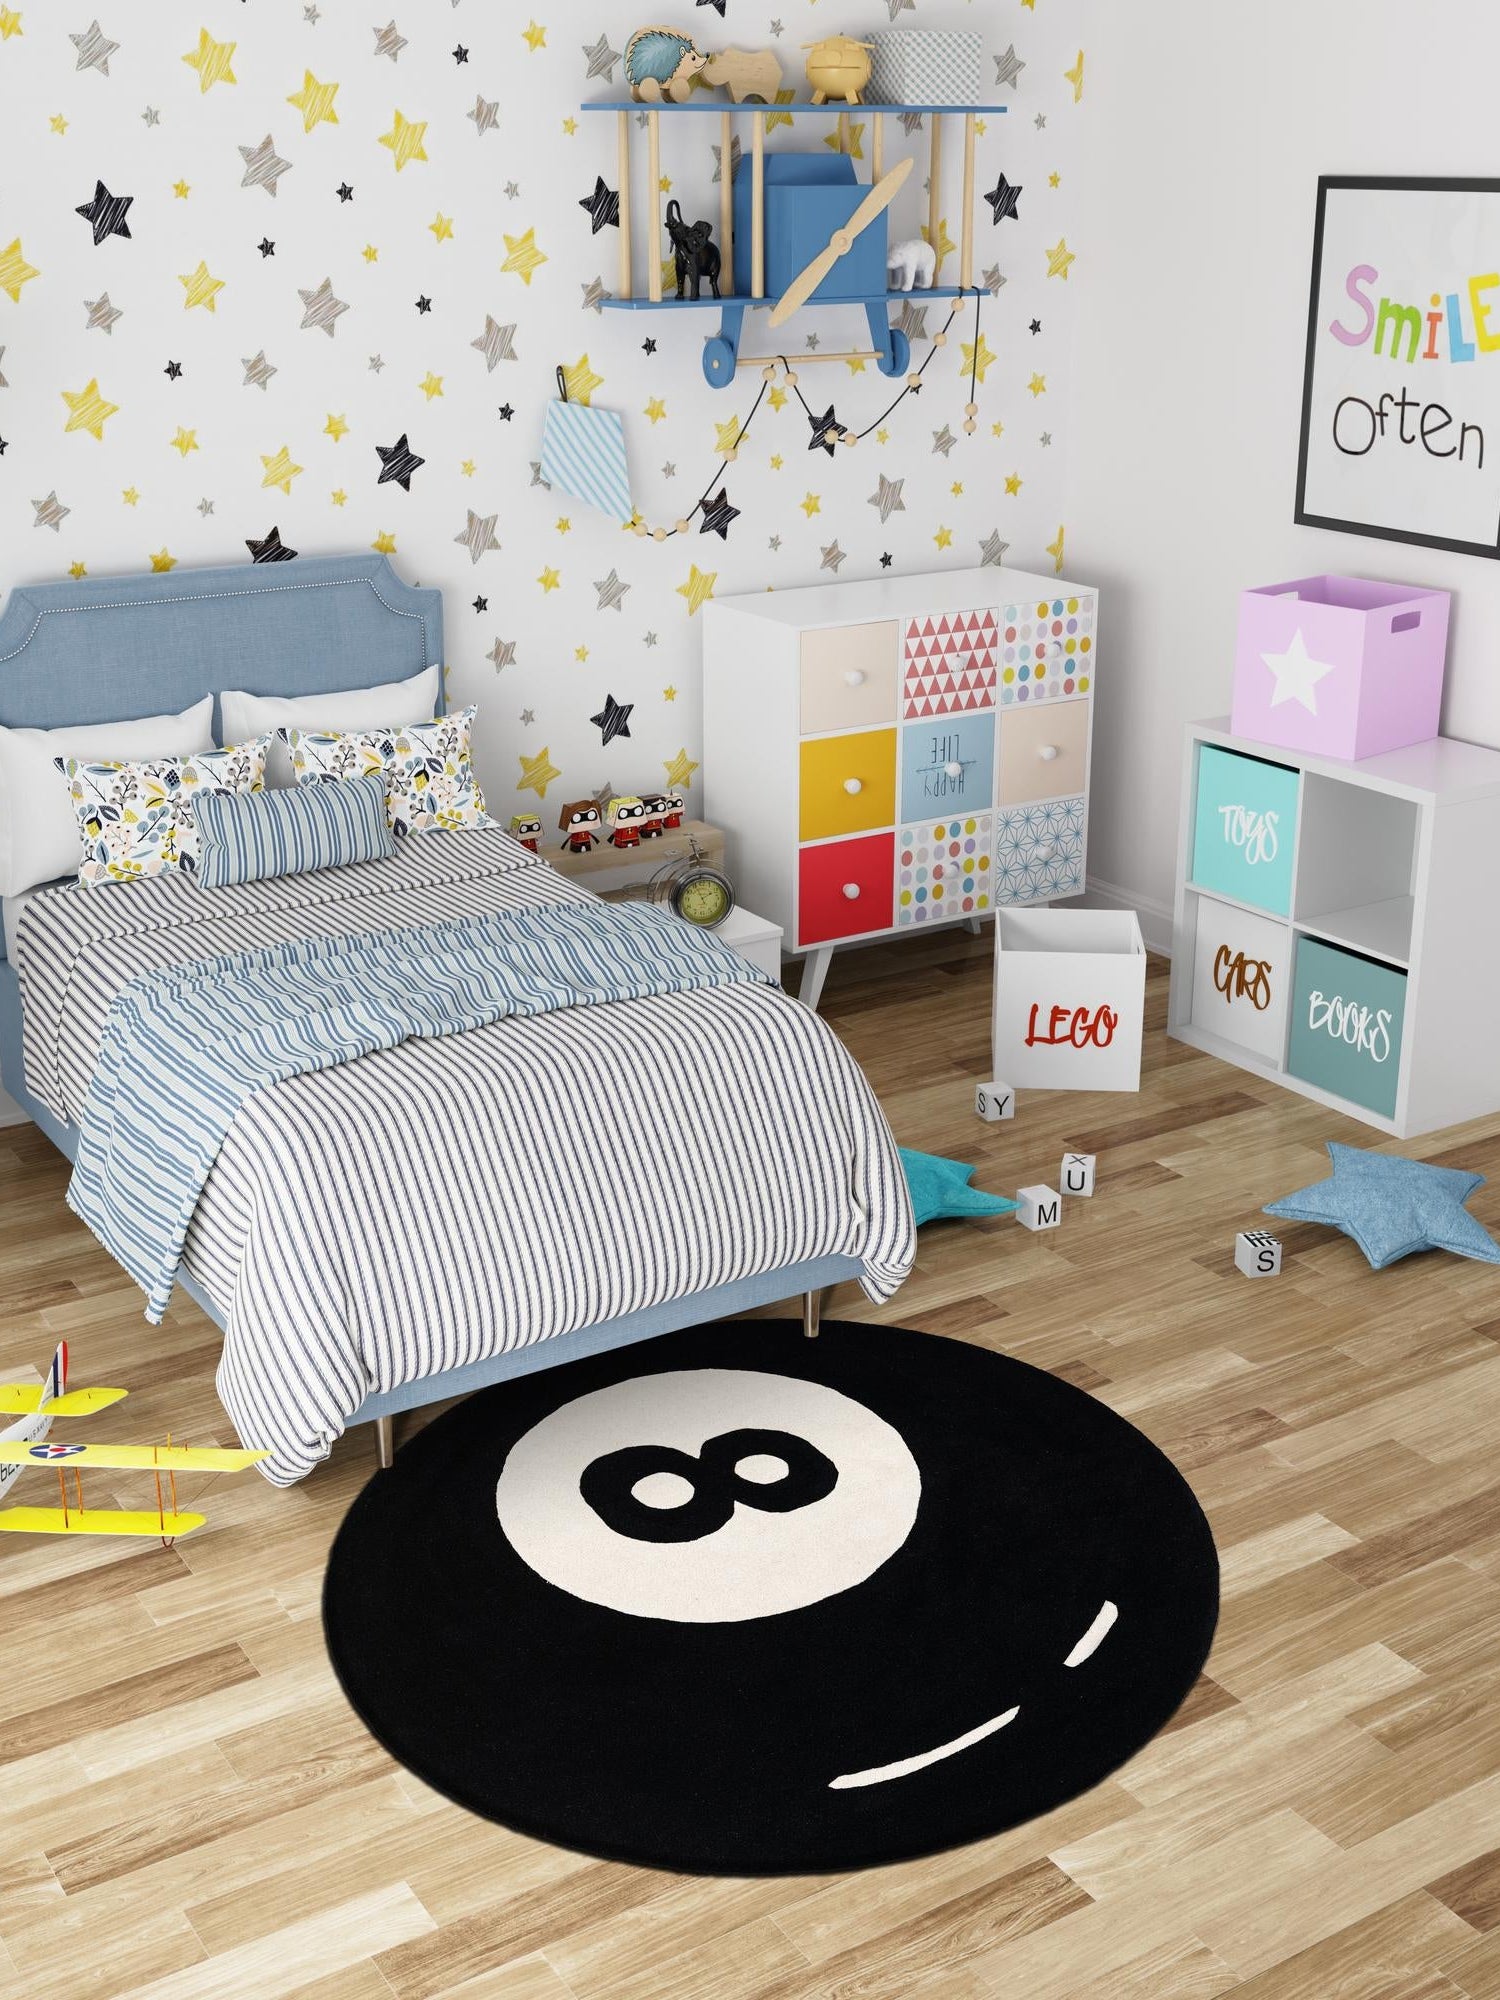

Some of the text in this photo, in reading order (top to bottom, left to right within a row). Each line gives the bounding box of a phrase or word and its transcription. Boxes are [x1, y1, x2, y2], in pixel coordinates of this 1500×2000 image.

[1333, 387, 1483, 469] Often
[931, 734, 959, 764] LIFE
[924, 768, 965, 798] HAPPY
[1213, 944, 1272, 1010] CARS
[1024, 1003, 1118, 1049] LEGO
[1309, 990, 1392, 1062] BOOKS
[994, 1095, 1010, 1116] Y
[1068, 1155, 1088, 1166] X
[1067, 1169, 1086, 1191] U
[1037, 1201, 1058, 1226] M
[1256, 1249, 1275, 1273] S
[579, 1427, 839, 1544] 8
